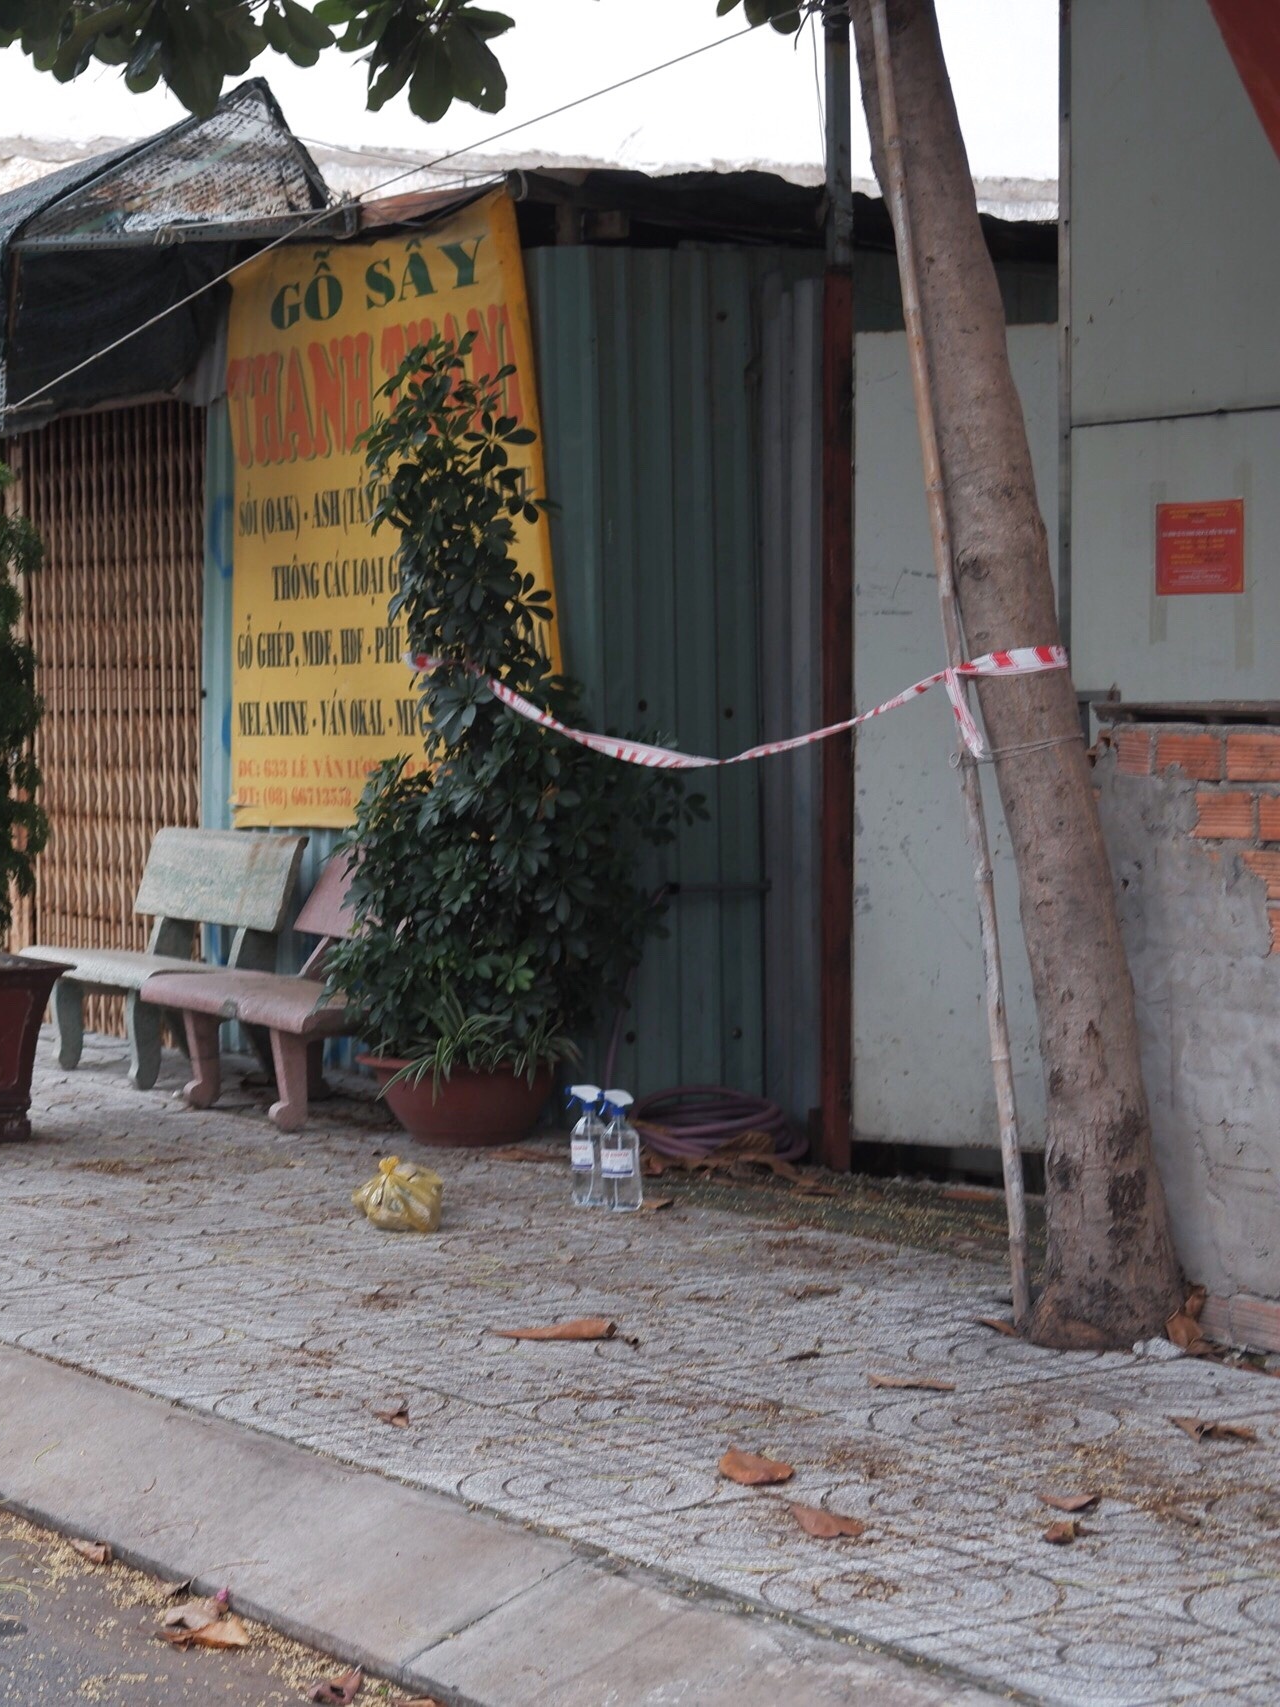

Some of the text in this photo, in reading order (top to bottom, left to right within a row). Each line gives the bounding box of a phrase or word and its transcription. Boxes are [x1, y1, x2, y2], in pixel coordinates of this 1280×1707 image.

[270, 249, 343, 331] GỖ
[226, 331, 374, 469] THANH
[260, 494, 301, 543] (OAK)
[312, 488, 340, 530] ASH
[271, 553, 320, 602] THÔNG
[323, 549, 350, 598] CÁC
[352, 556, 384, 606] LOẠI
[340, 627, 365, 666] HDF
[237, 700, 310, 739] MELAMINE
[320, 688, 347, 737] VÁN
[348, 698, 386, 737] OKAL
[263, 758, 288, 778] 633
